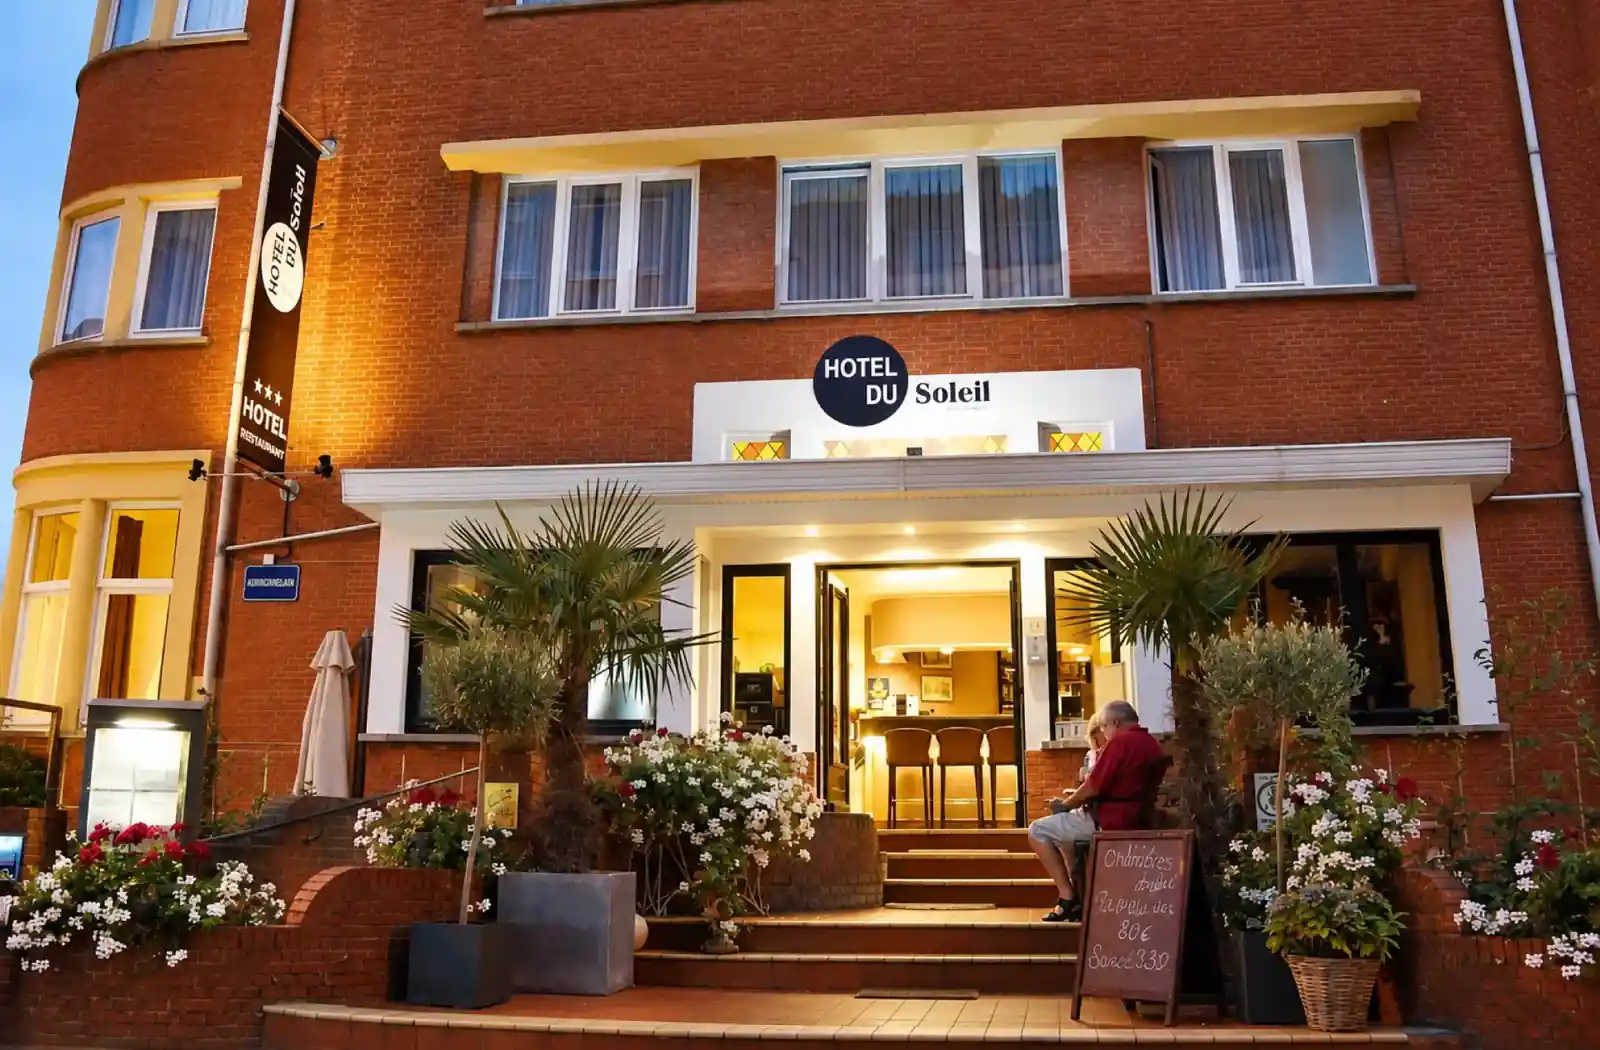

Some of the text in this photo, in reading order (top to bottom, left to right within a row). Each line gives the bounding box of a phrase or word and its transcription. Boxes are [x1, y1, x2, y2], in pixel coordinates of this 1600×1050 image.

[268, 231, 286, 296] HOTEL
[824, 356, 898, 379] HOTEL
[865, 380, 990, 405] DU Soleil
[242, 395, 287, 441] HOTEL
